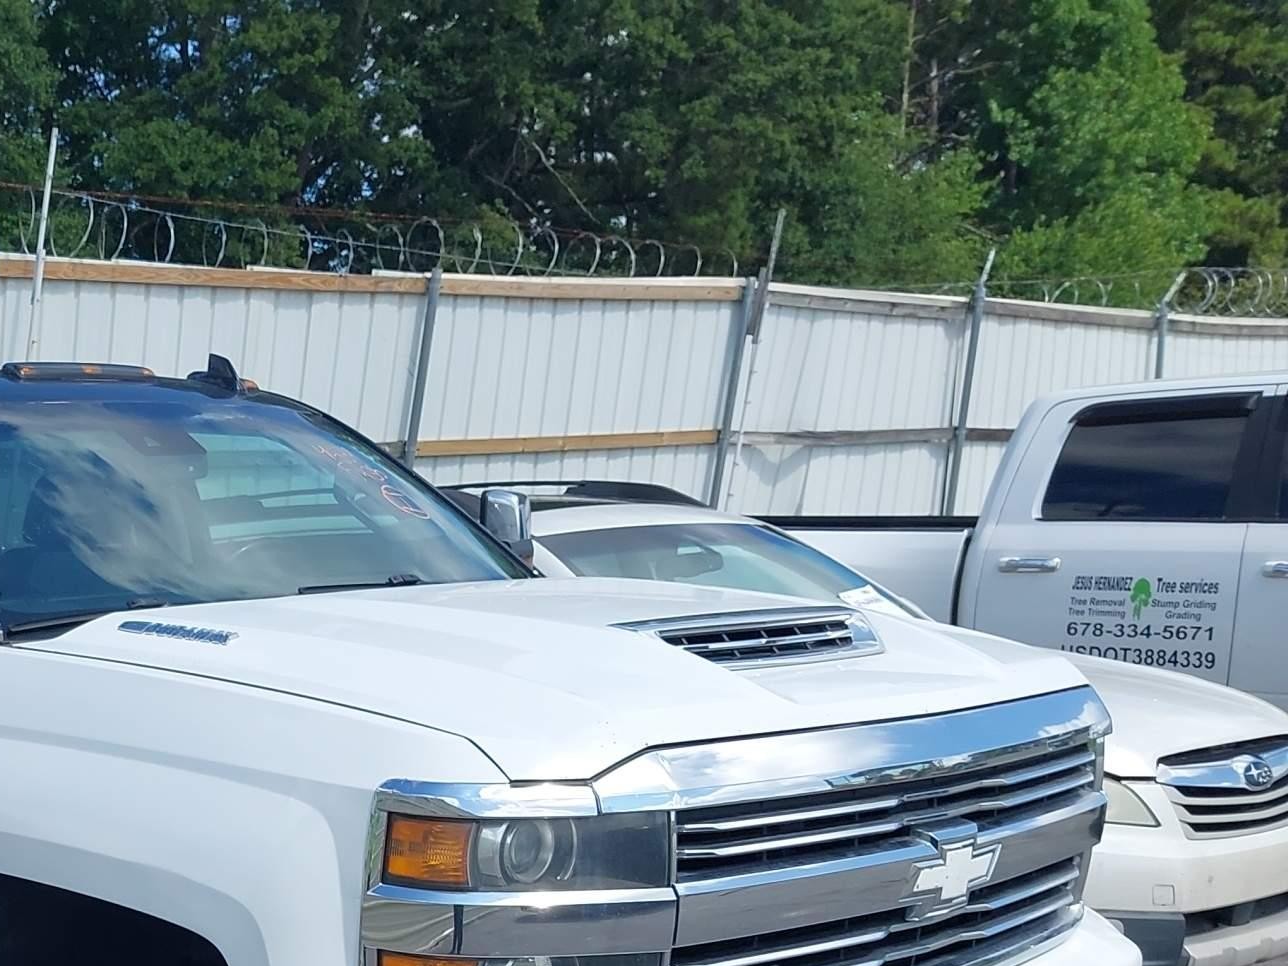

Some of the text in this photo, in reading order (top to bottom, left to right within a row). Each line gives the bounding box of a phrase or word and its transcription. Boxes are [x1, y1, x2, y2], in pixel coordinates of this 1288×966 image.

[1072, 576, 1133, 592] JESUS HERNANDEZ
[1156, 578, 1219, 594] Tree services
[1070, 597, 1126, 606] Tree Removal
[1151, 599, 1180, 609] Stump
[1068, 607, 1126, 619] Tree Trimming
[1165, 610, 1202, 622] Grading
[1067, 622, 1214, 641] 678-334-5671
